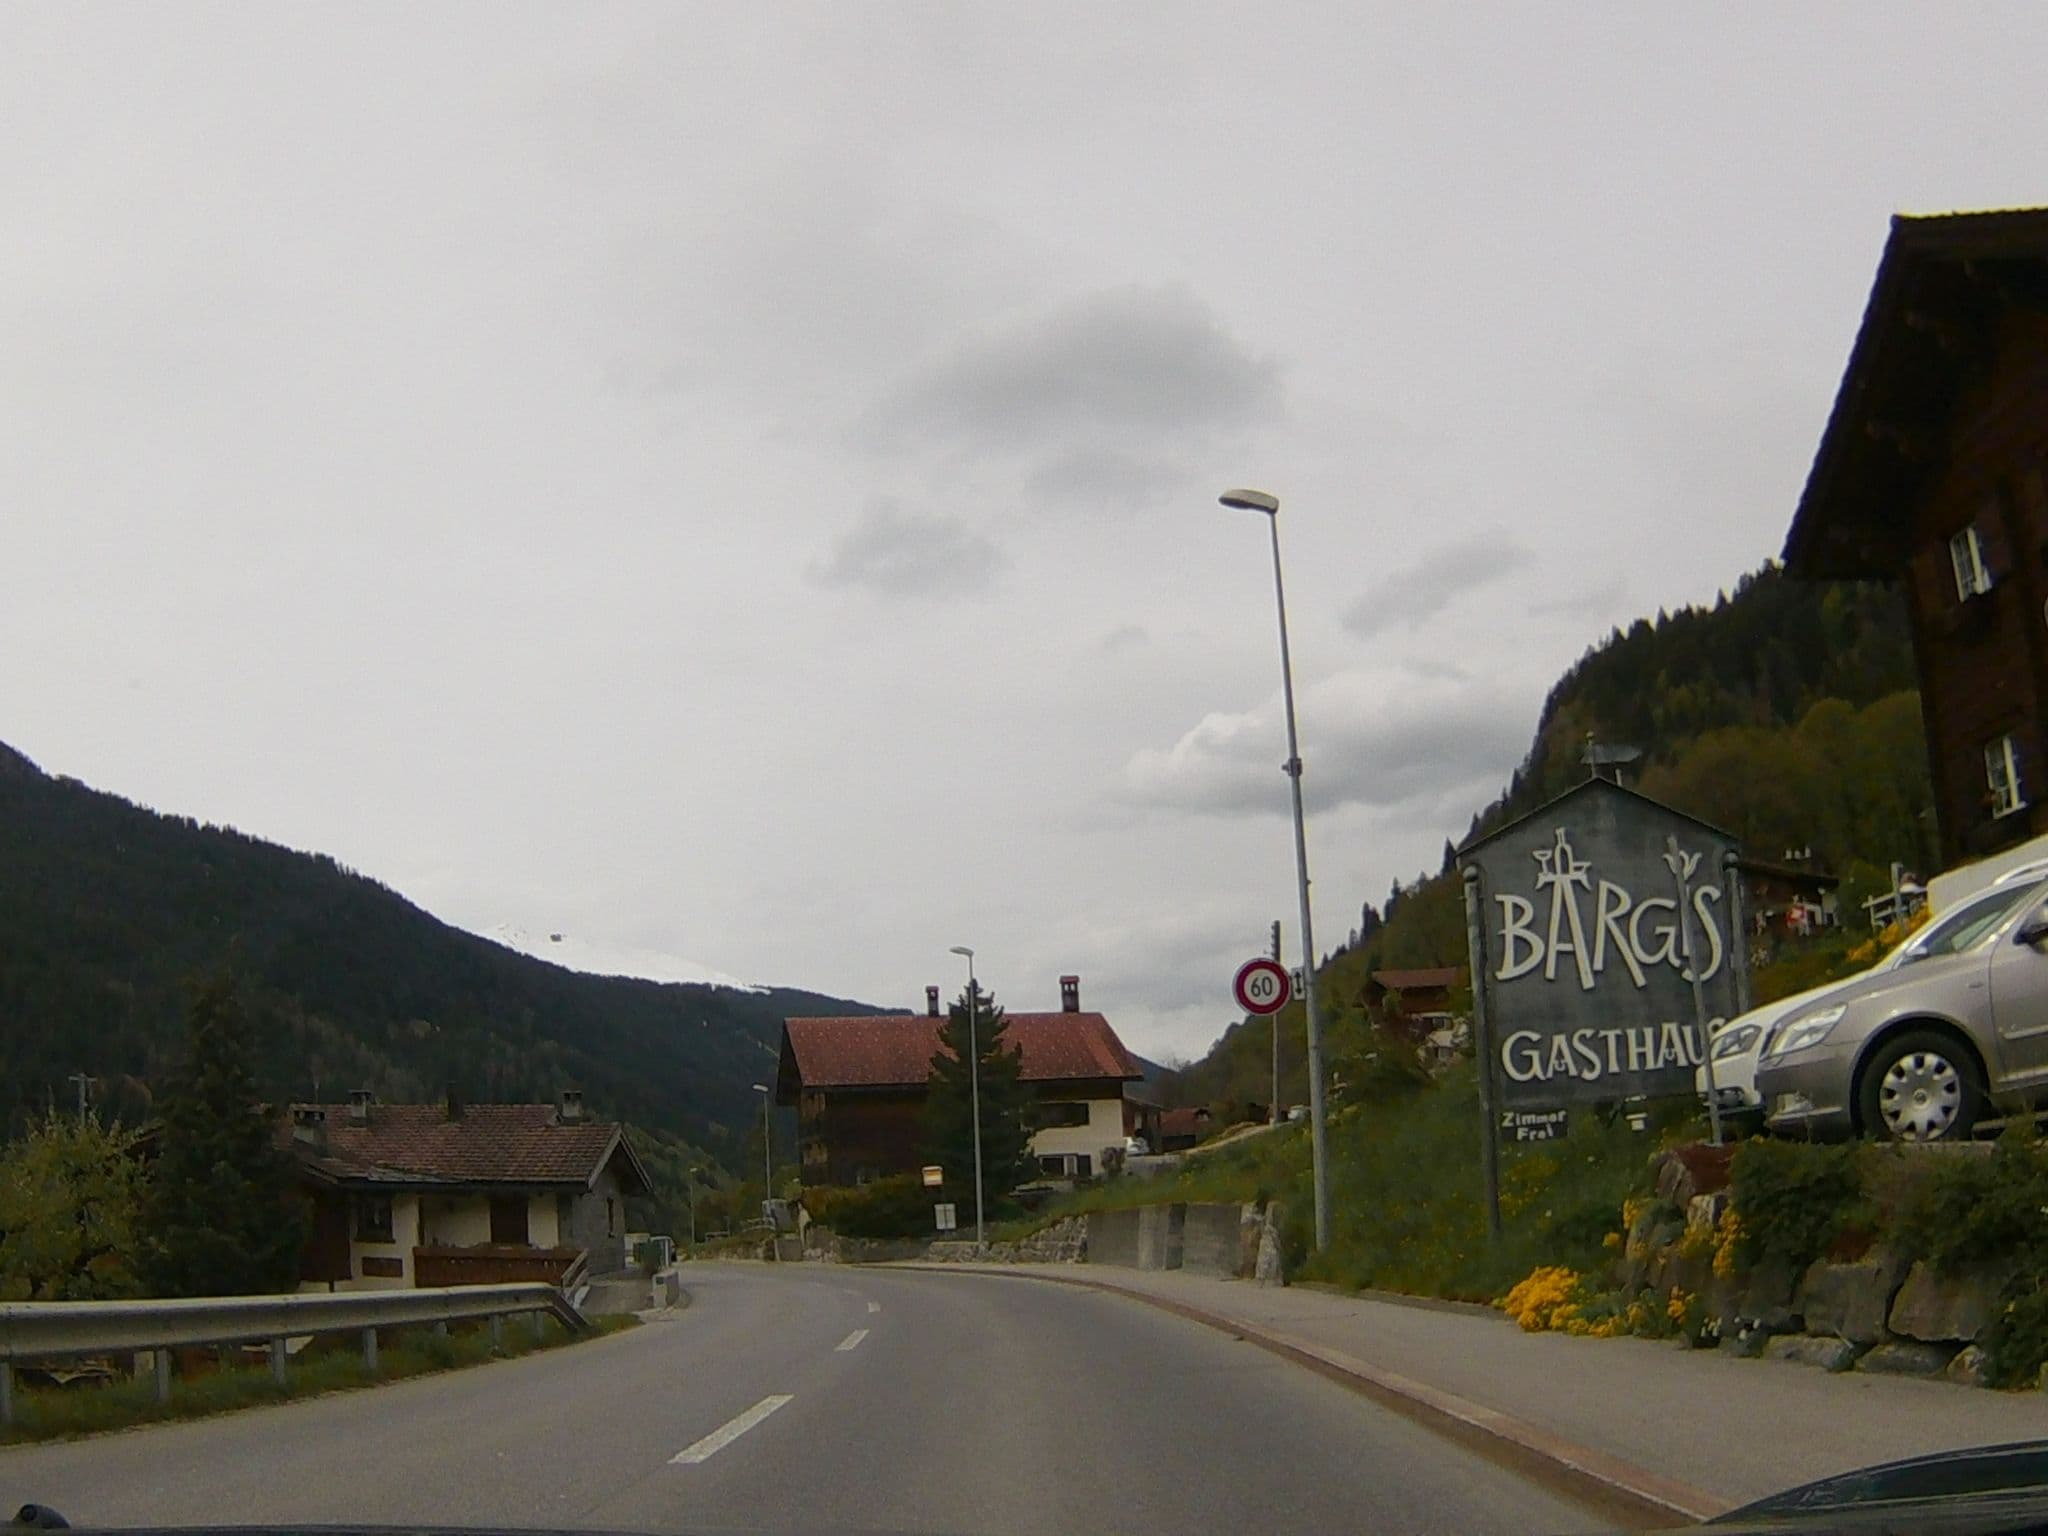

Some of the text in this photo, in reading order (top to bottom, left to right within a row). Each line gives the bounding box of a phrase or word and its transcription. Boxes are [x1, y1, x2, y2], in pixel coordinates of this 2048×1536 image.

[1250, 976, 1273, 997] 60
[1501, 1109, 1567, 1128] Zimmer
[1515, 1123, 1554, 1142] Frei
